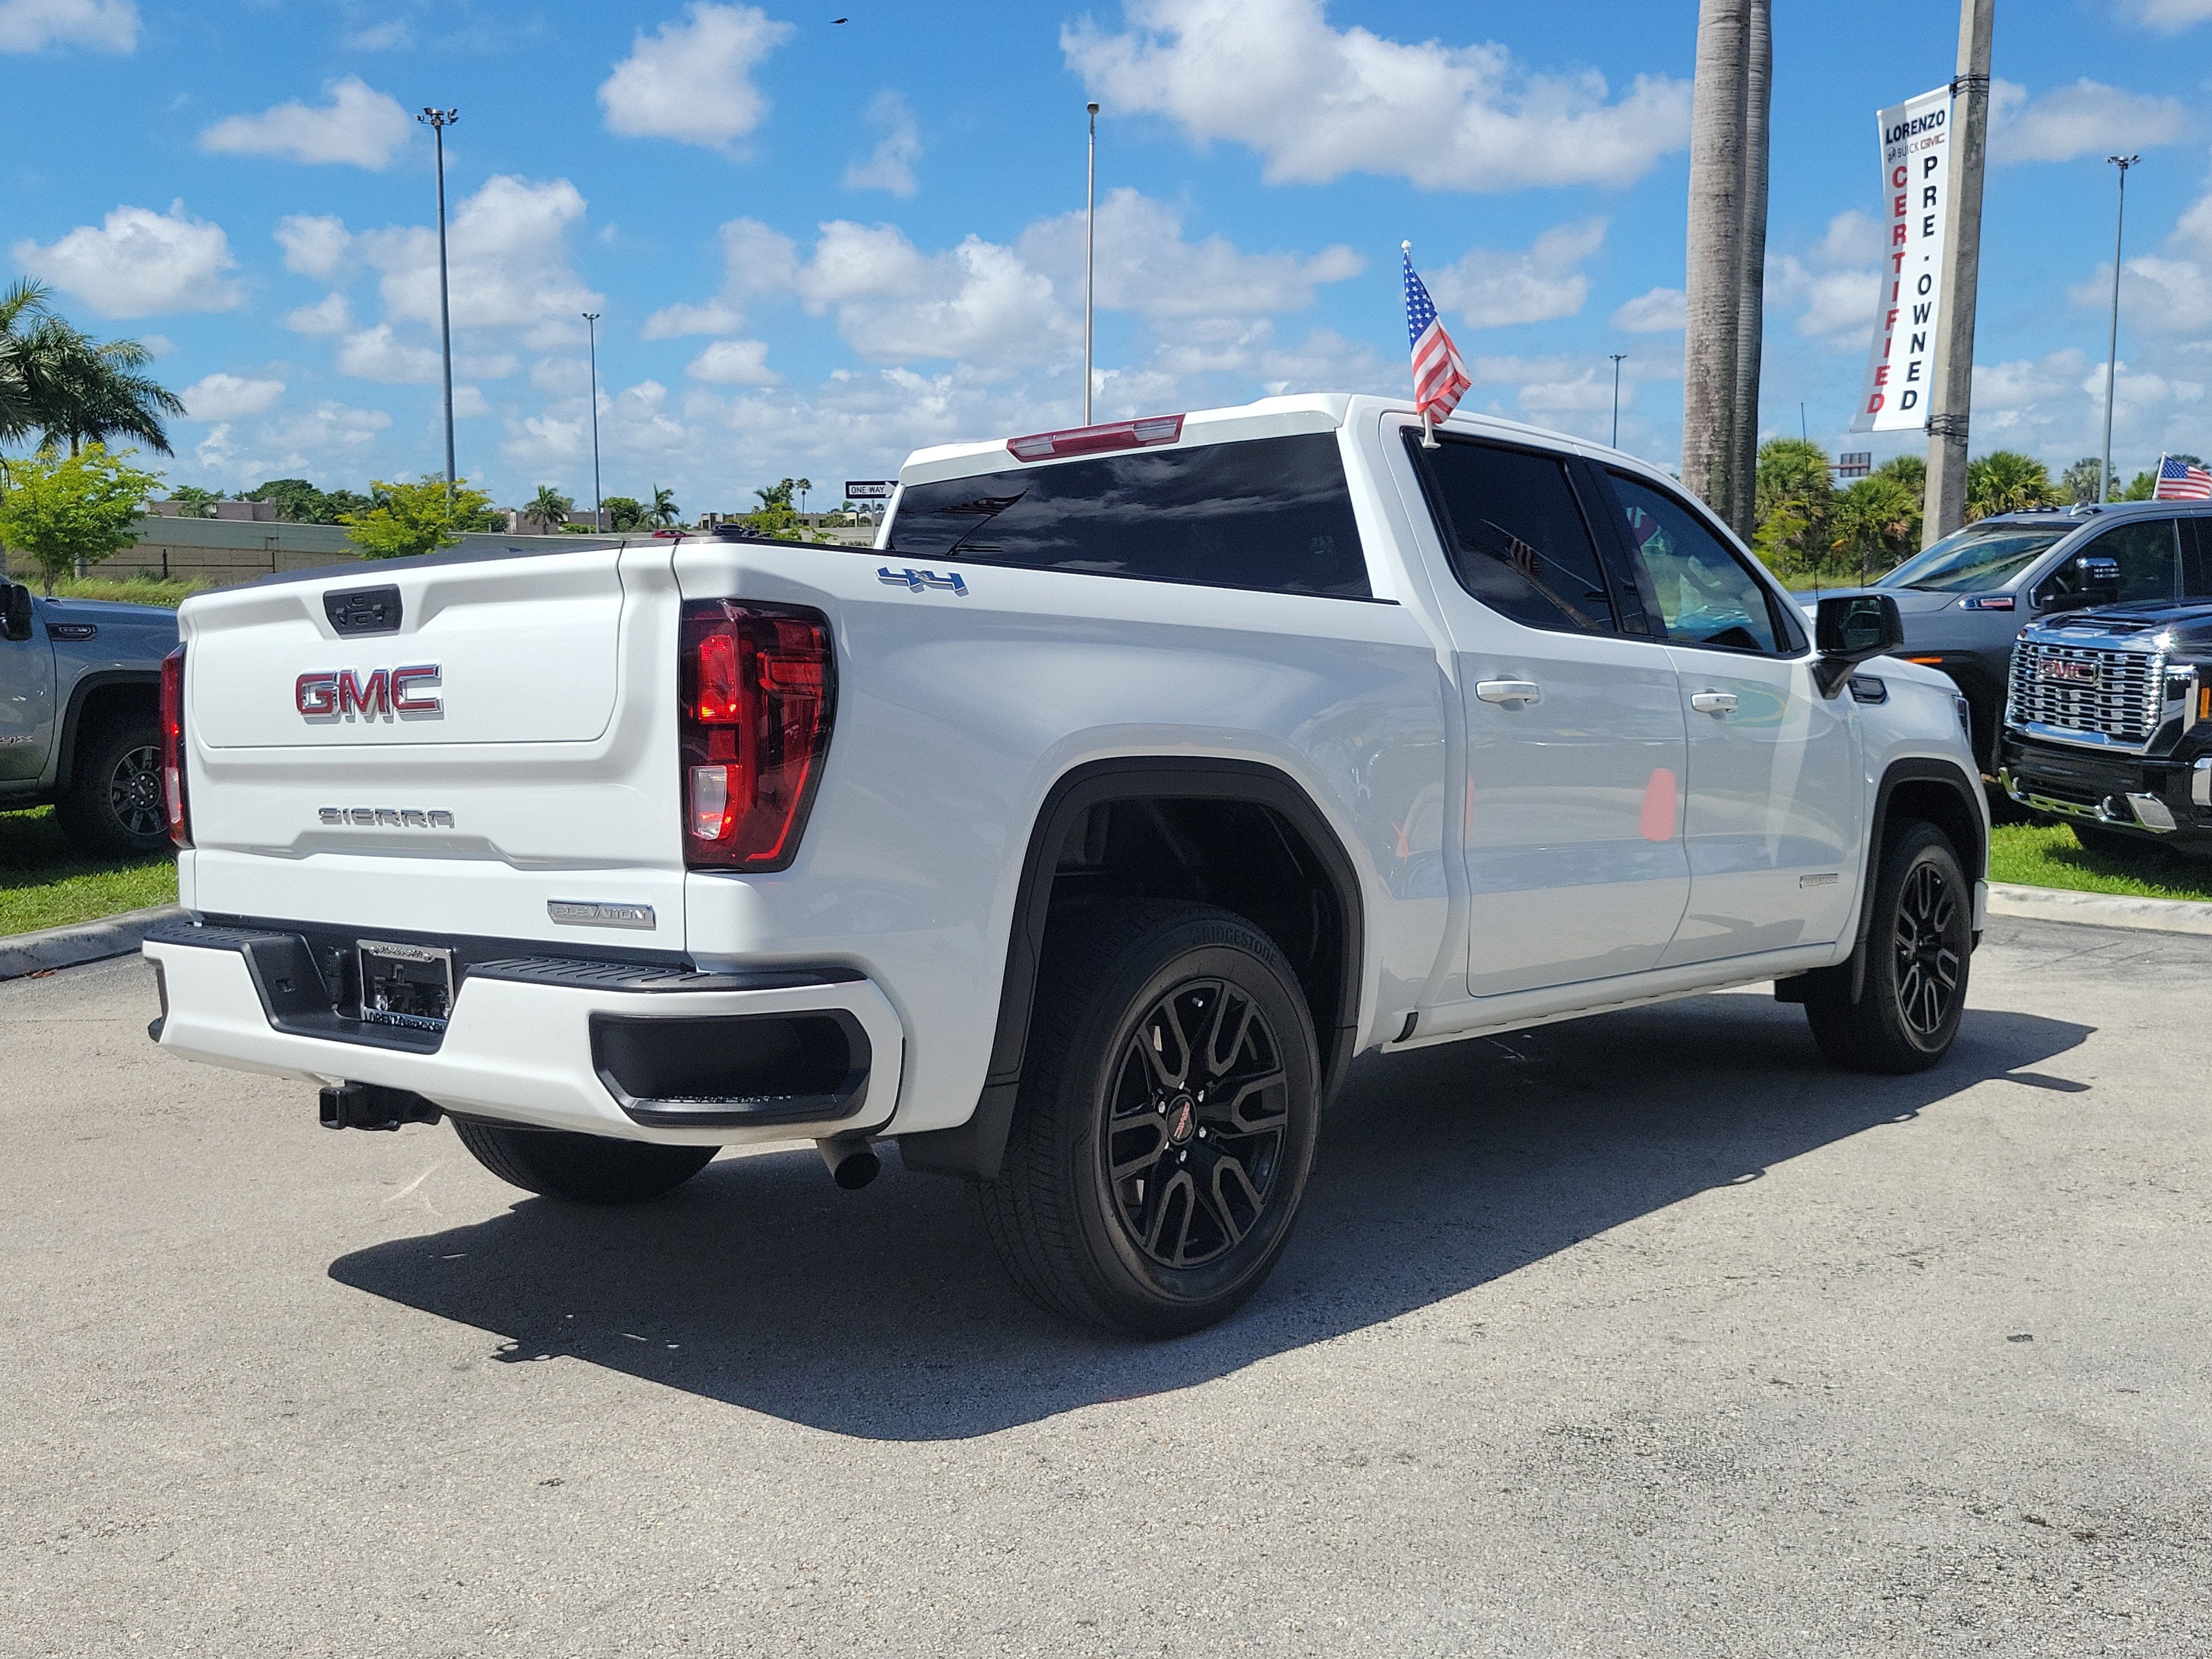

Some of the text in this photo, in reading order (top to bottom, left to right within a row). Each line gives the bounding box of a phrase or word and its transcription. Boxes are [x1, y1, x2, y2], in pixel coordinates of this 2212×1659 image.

[1886, 110, 1945, 145] LORENZO
[1898, 132, 1945, 158] BUICK GMC
[1866, 165, 1908, 414] CERTIFIED
[2038, 659, 2095, 682] GMC
[296, 662, 443, 718] GMC
[318, 807, 455, 828] SIERRA
[556, 905, 646, 921] ELEVATION
[1174, 1101, 1190, 1139] GMC
